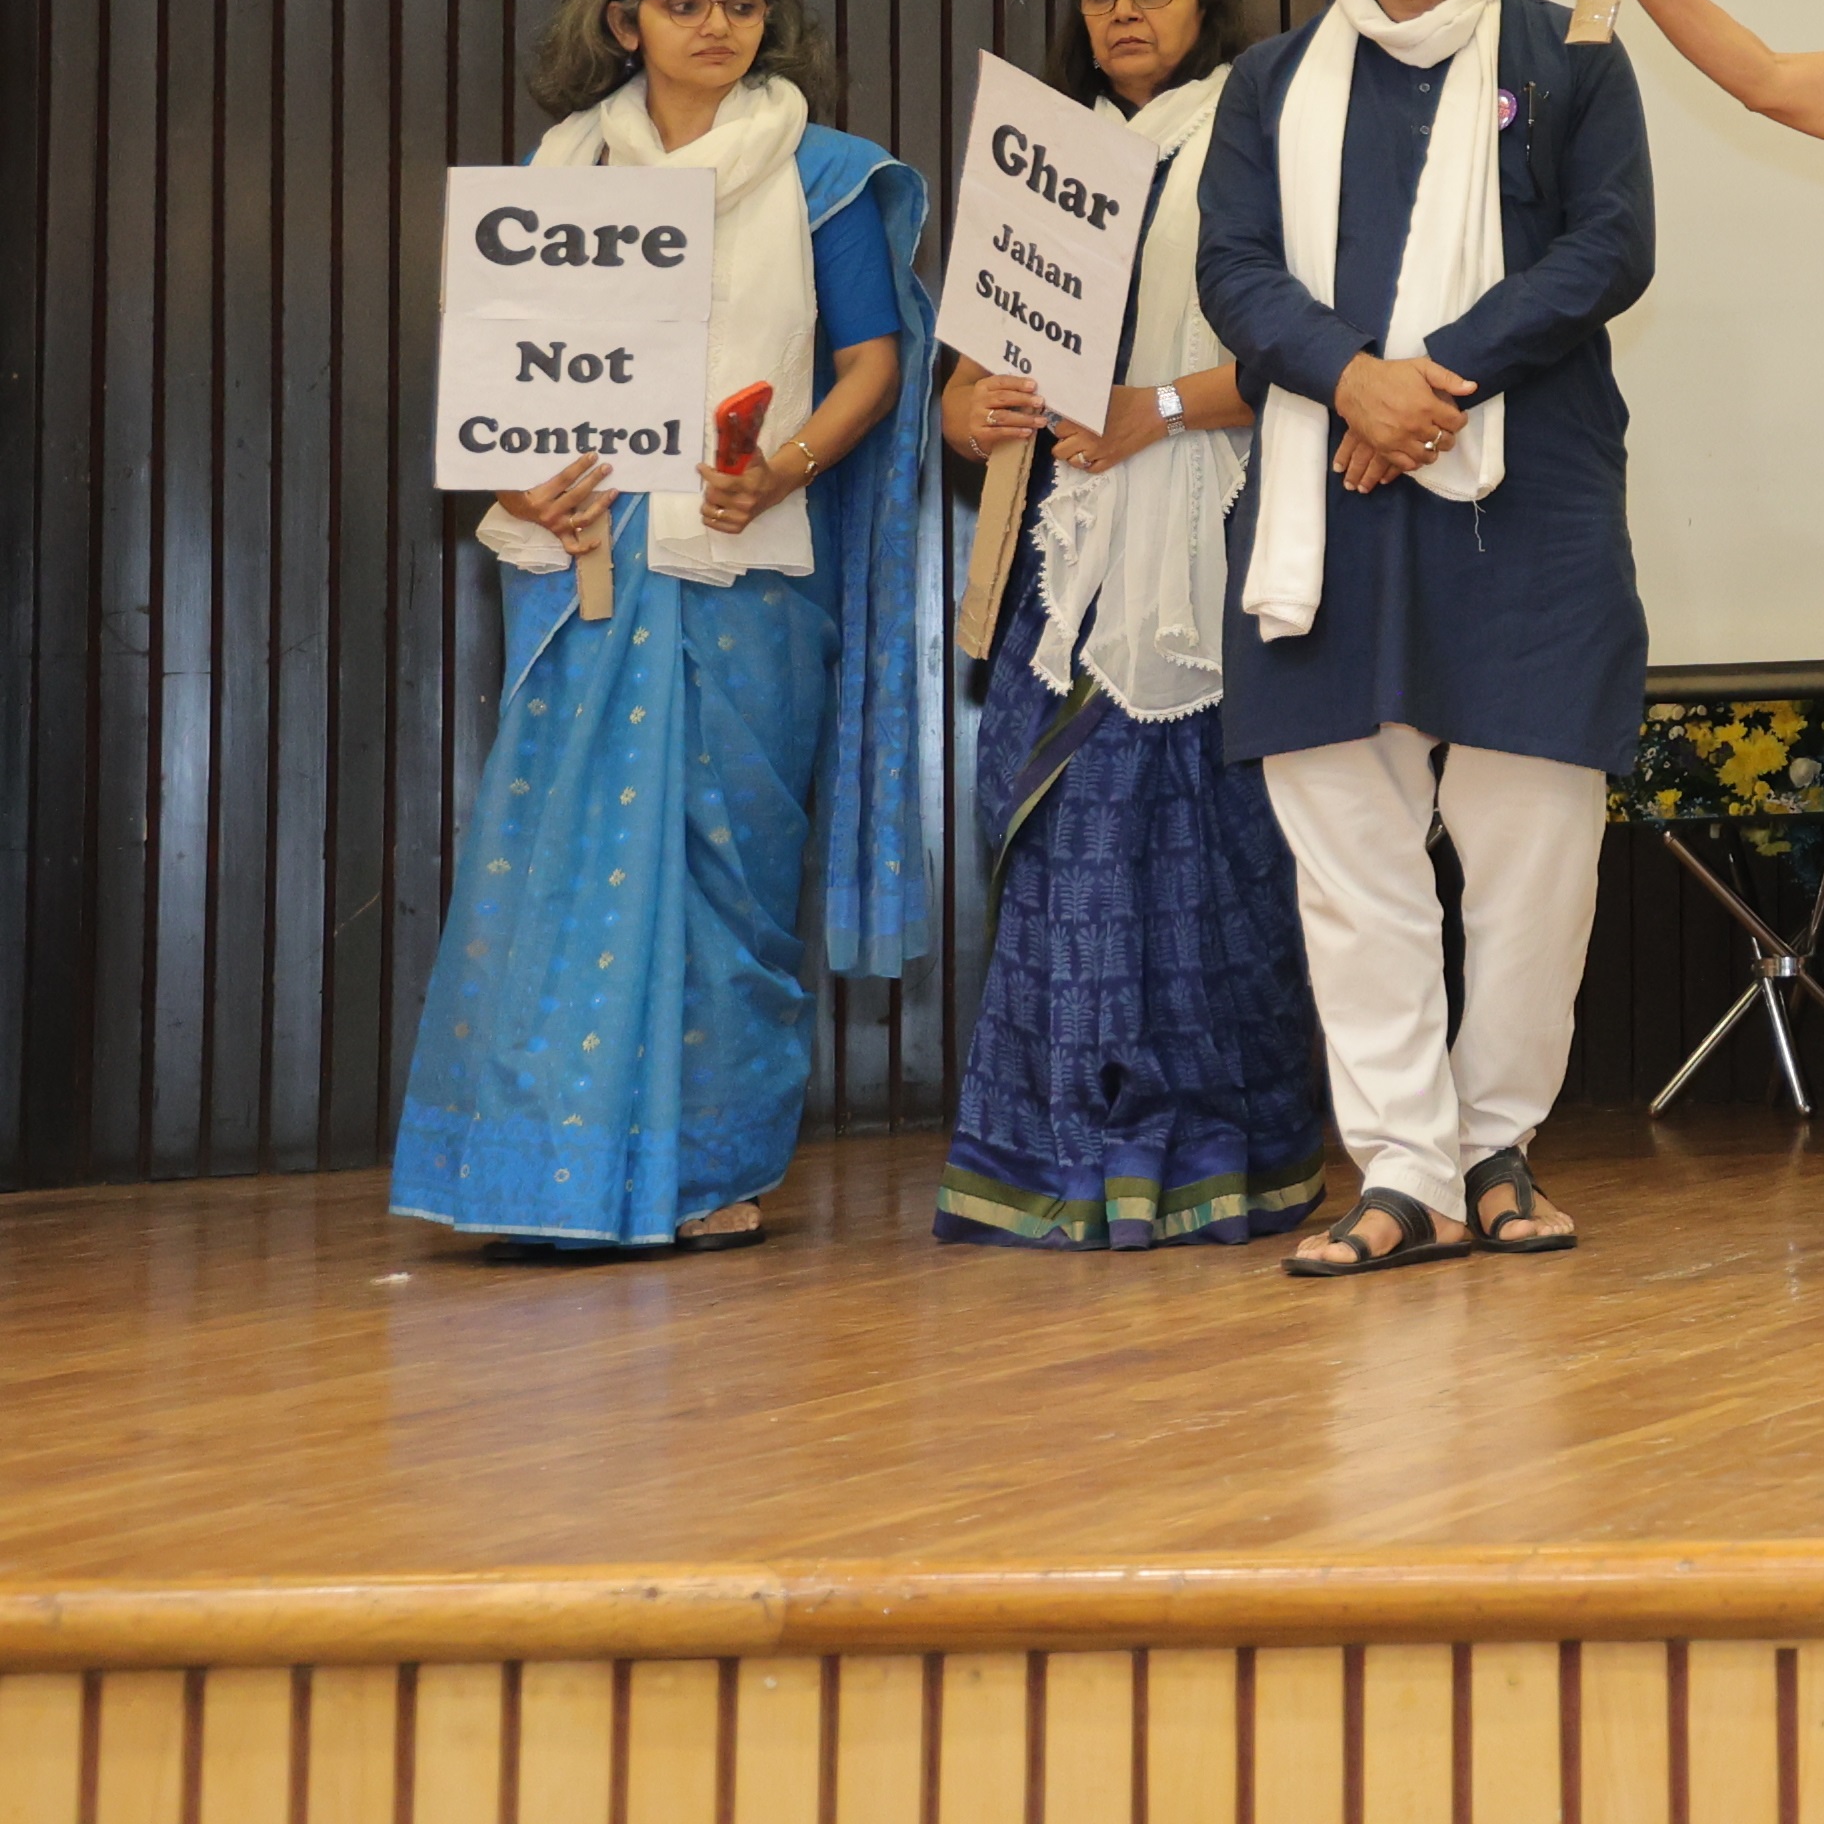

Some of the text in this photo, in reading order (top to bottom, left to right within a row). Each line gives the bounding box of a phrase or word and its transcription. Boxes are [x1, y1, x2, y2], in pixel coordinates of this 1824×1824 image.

[991, 123, 1120, 232] Ghar
[474, 205, 688, 269] Care
[992, 223, 1084, 301] Jahan
[975, 268, 1084, 356] Sukoon
[514, 340, 635, 385] Not
[1002, 339, 1033, 376] Ho
[457, 414, 682, 457] Control
